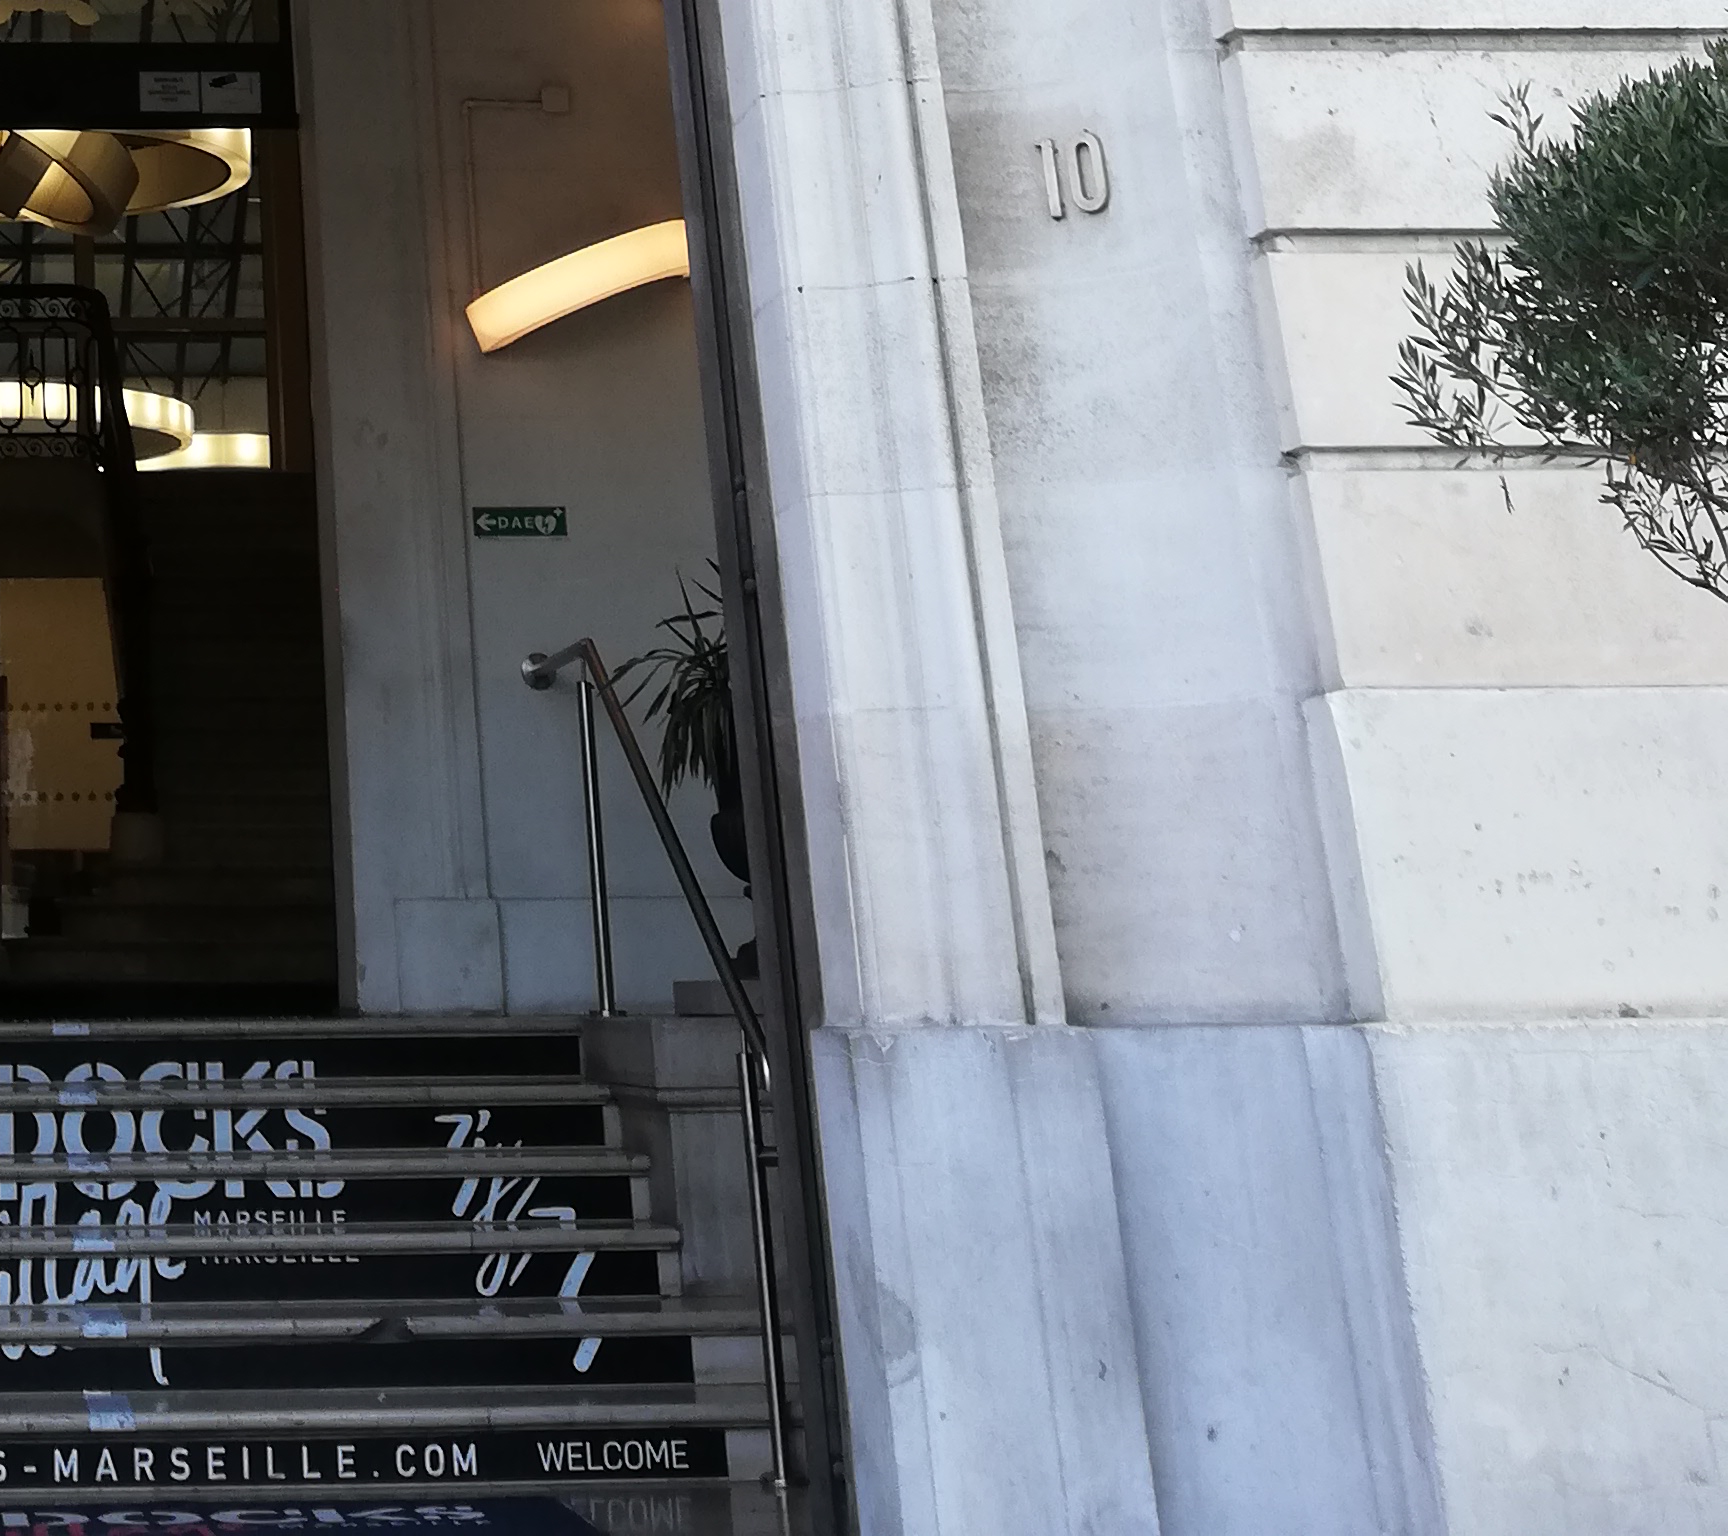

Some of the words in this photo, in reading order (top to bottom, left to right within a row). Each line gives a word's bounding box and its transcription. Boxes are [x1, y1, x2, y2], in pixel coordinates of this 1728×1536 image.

[1034, 128, 1111, 221] 10
[497, 516, 534, 529] DAE
[537, 1439, 690, 1472] WELCOME
